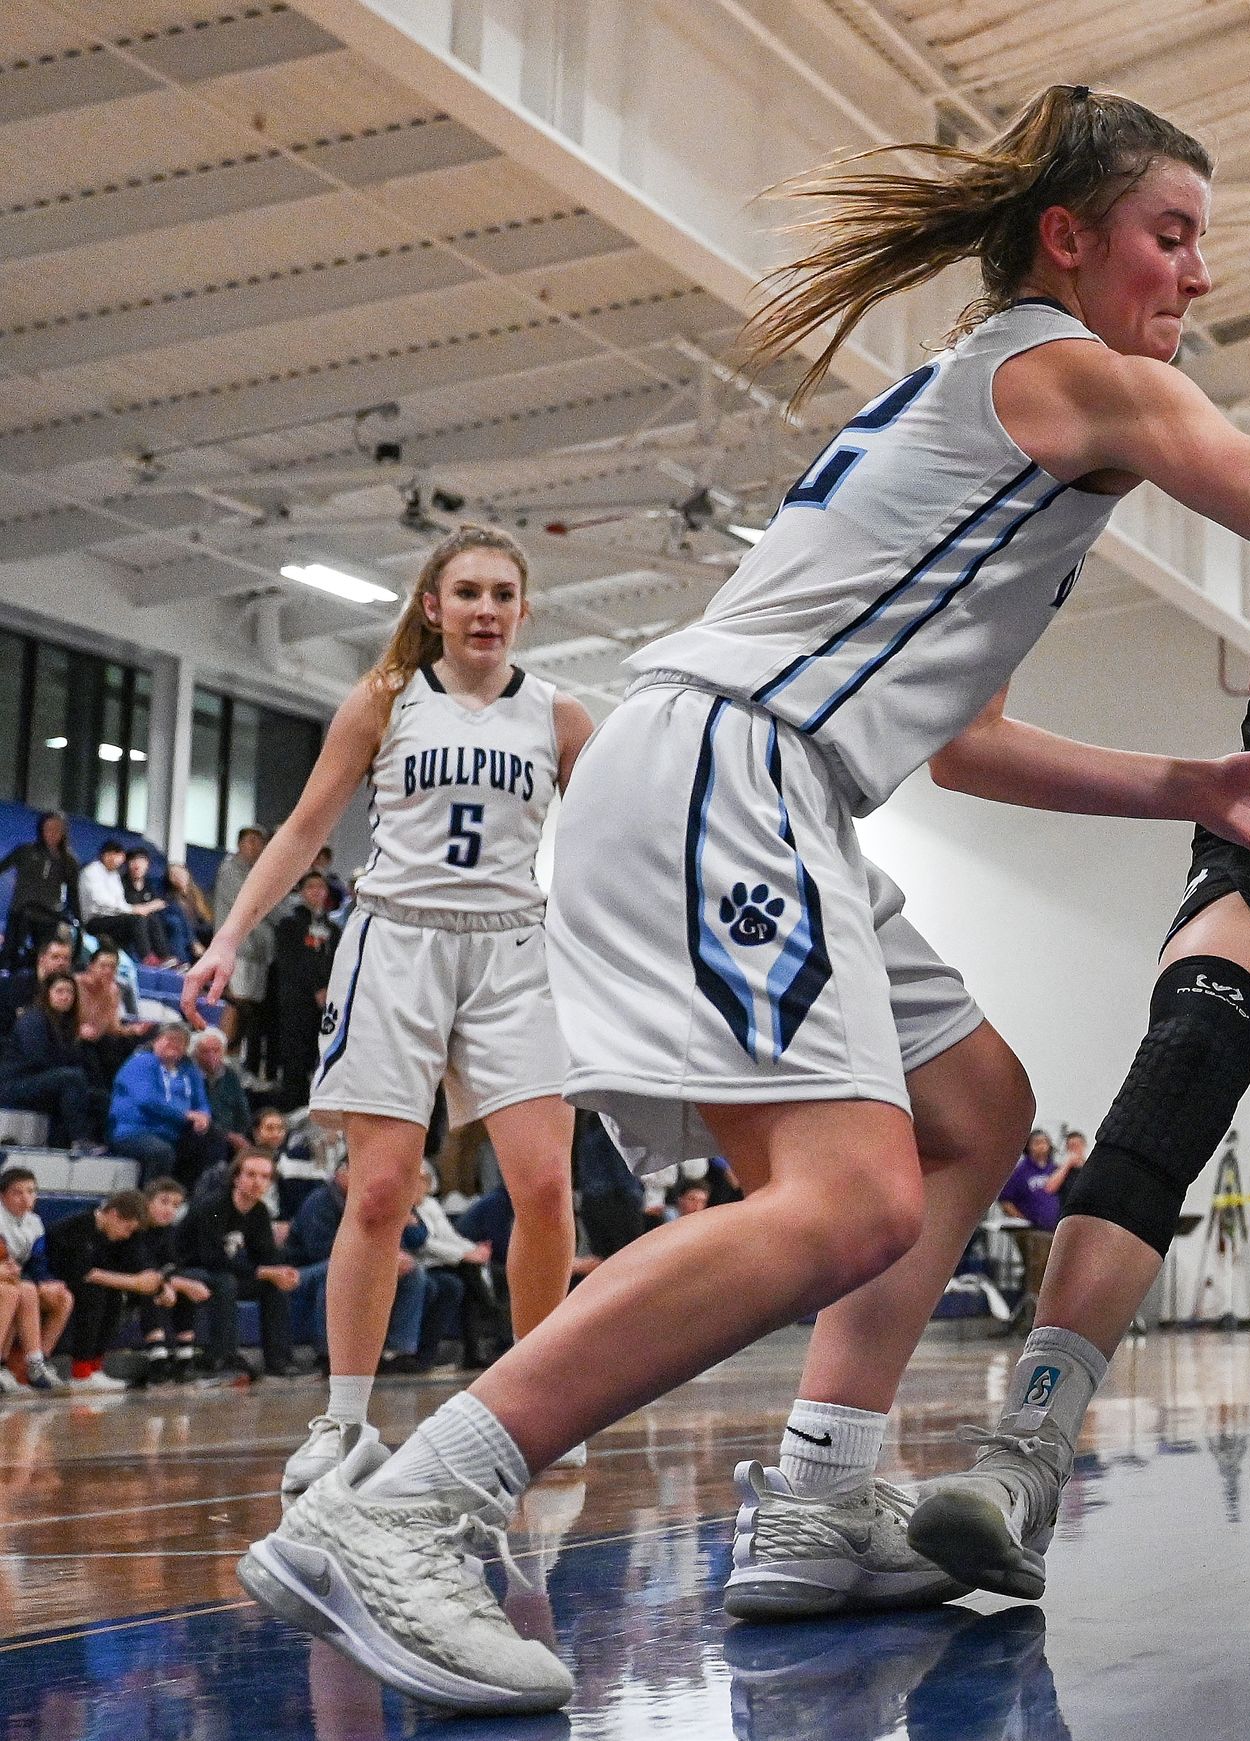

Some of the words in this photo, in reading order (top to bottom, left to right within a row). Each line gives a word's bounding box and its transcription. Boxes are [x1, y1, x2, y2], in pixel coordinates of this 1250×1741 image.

[404, 746, 534, 802] BULLPUPS
[446, 802, 485, 869] 5
[739, 918, 768, 939] GP
